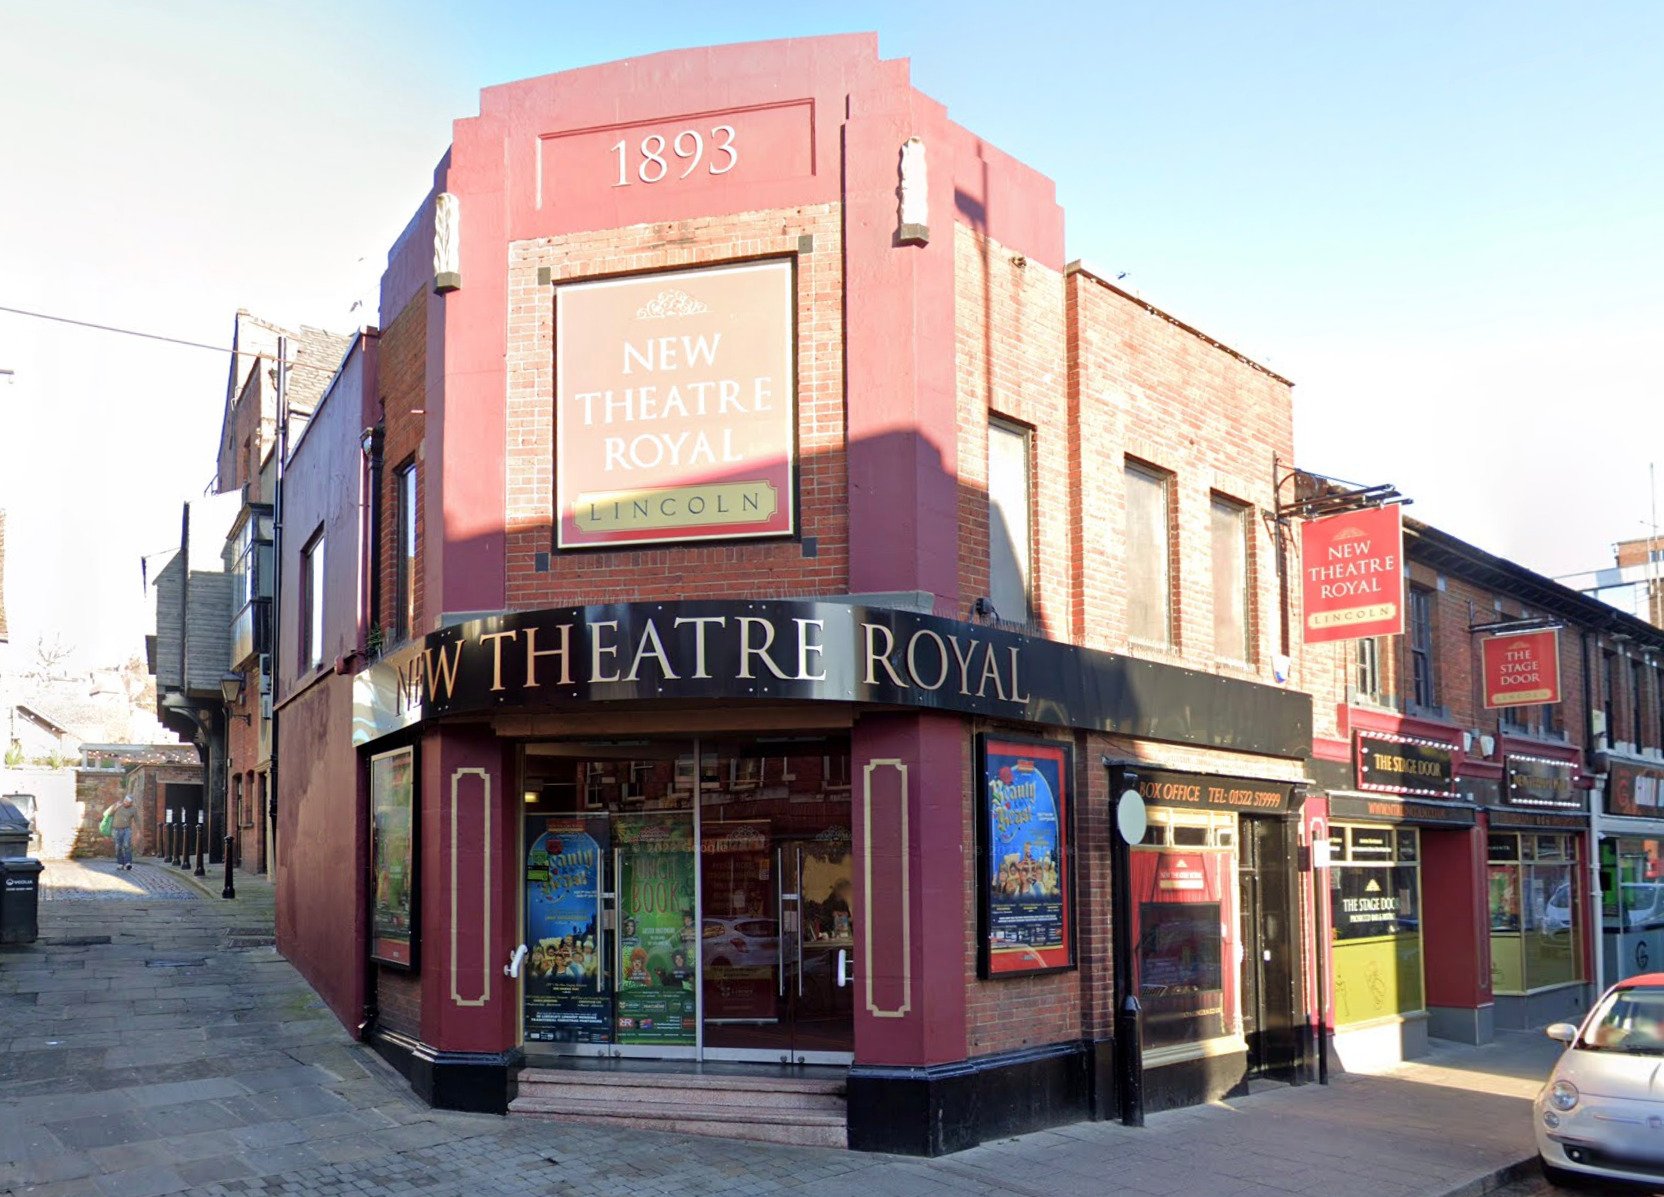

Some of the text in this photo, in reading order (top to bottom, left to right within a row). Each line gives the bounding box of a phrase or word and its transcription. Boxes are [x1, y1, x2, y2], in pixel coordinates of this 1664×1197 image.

[610, 124, 739, 188] 1893
[620, 332, 722, 375] NEW
[574, 375, 773, 426] THEATRE
[603, 427, 744, 473] ROYAL
[589, 491, 761, 522] LINCOLN
[1328, 540, 1371, 561] NEW
[1308, 555, 1394, 581] THEATRE
[1321, 577, 1382, 599] ROYAL
[1314, 607, 1389, 624] LINCOLN
[396, 615, 1031, 717] NEW THEATRE ROYAL
[1500, 661, 1539, 674] STAGE
[1505, 650, 1532, 661] THE
[1501, 673, 1541, 685] DOOR
[1373, 753, 1442, 776] THE STAGE DOOR
[1139, 781, 1161, 799] BOX
[1162, 783, 1200, 802] OFFICE
[1208, 787, 1228, 804] TEL:
[1228, 789, 1253, 805] 01522
[631, 880, 681, 913] BOOK
[1342, 898, 1358, 912] THE
[1359, 897, 1380, 911] STAGE
